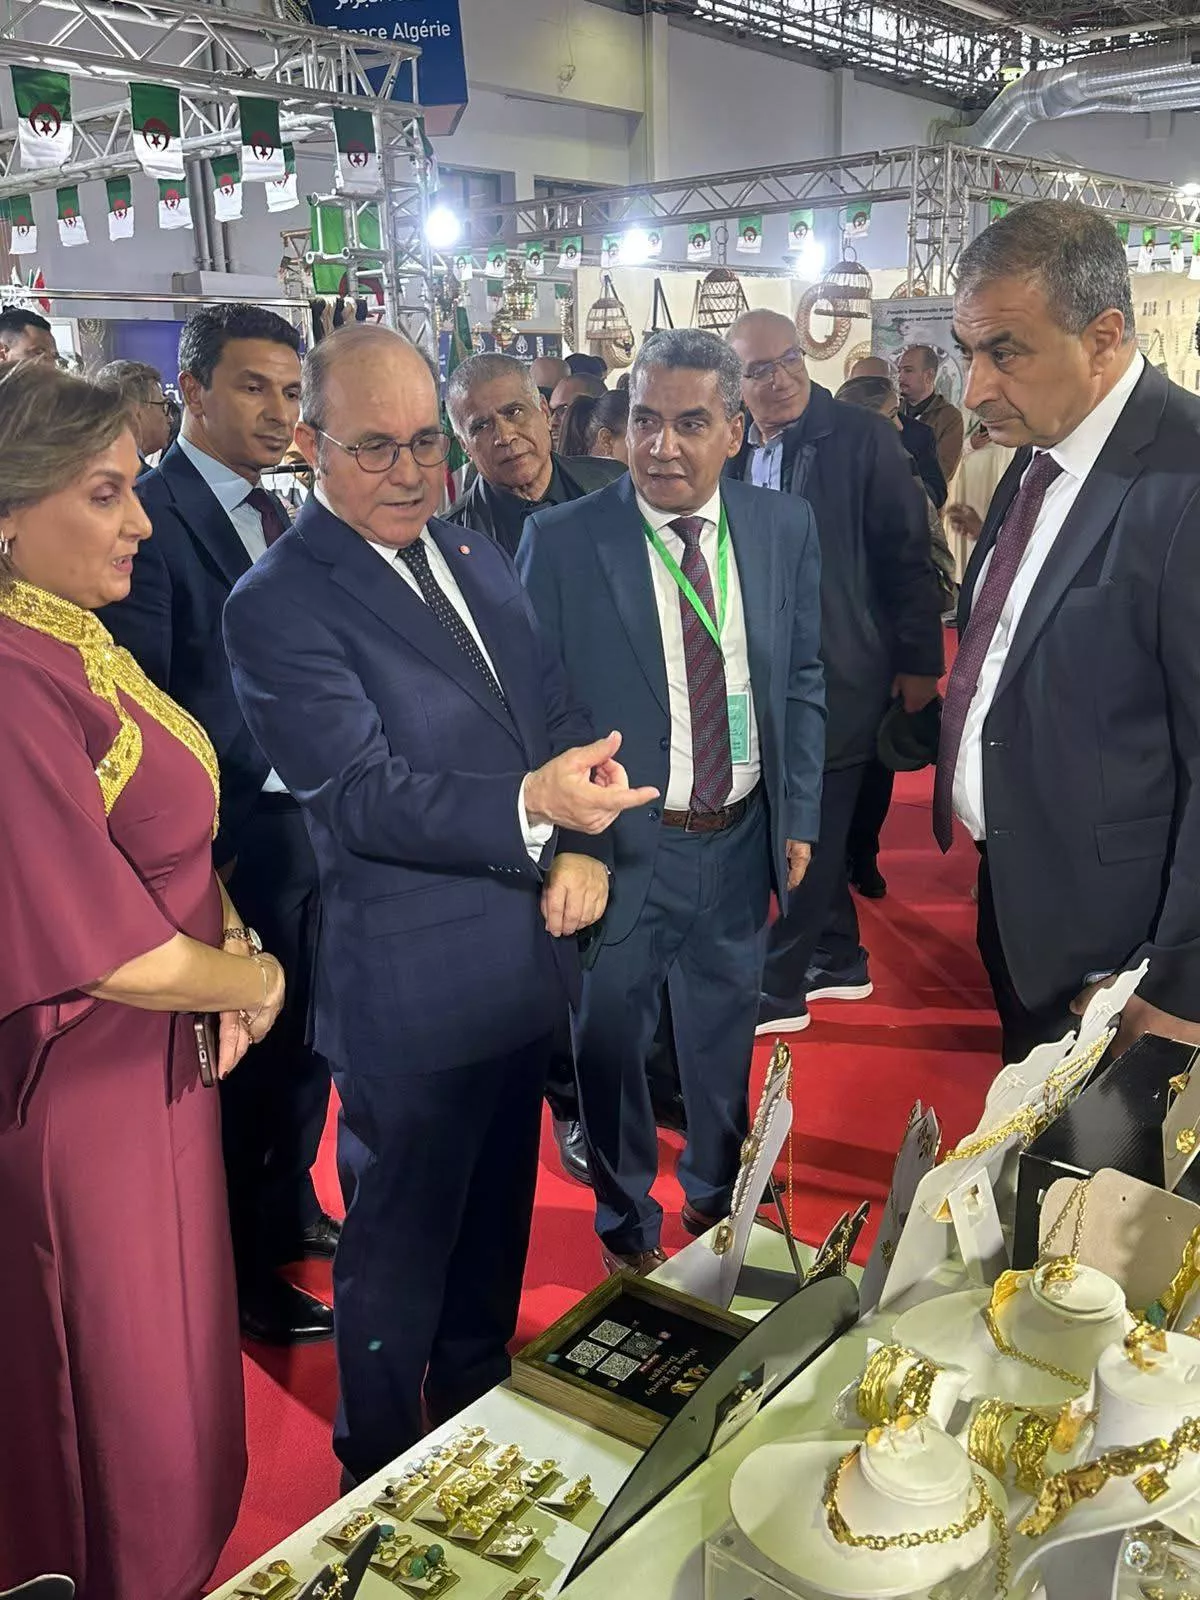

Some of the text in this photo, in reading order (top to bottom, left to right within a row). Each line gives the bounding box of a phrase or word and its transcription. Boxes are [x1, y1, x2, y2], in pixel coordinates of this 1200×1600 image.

[327, 19, 451, 43] ace Algérie
[648, 1355, 679, 1381] Designs
